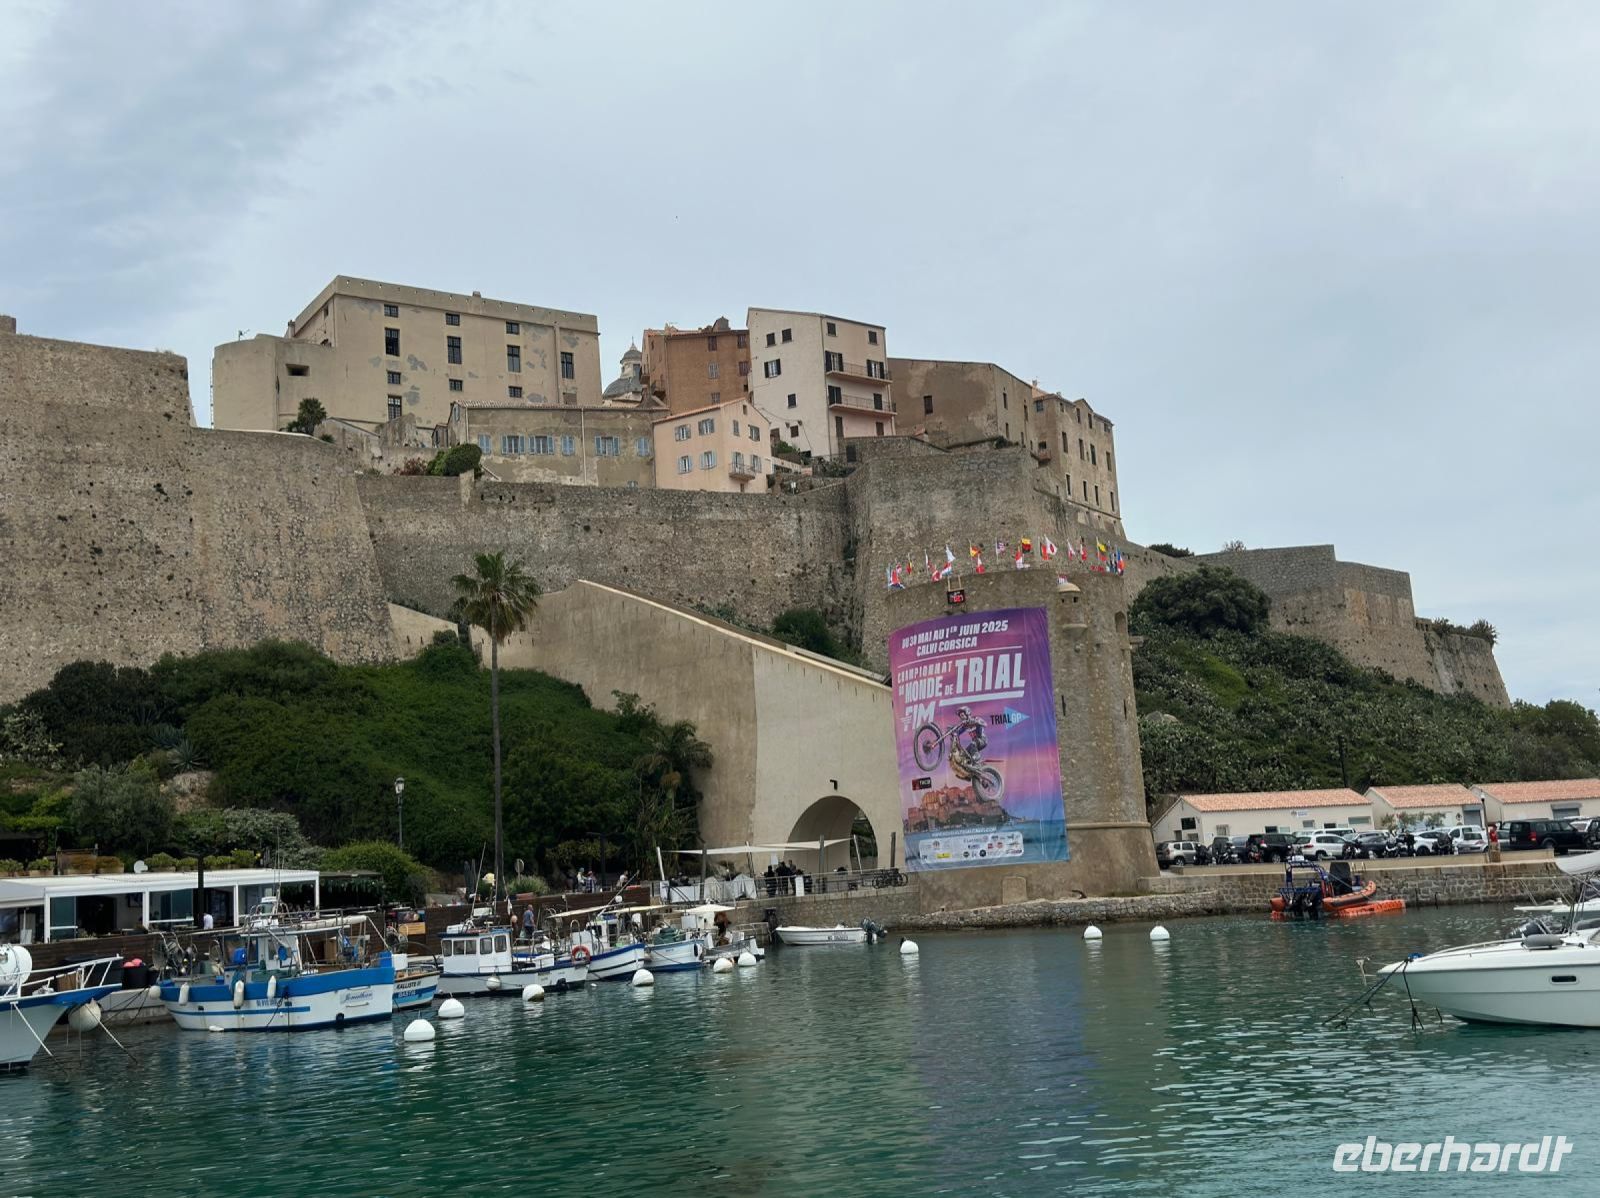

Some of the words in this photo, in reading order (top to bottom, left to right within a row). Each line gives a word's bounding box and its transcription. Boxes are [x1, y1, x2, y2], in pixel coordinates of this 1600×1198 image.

[918, 632, 932, 644] MAI
[933, 629, 945, 641] AU
[959, 624, 980, 636] JUIN
[982, 620, 1008, 633] 2025
[917, 642, 938, 657] CALVI
[938, 637, 977, 652] CORSICA
[898, 661, 952, 684] CHAMPIONNAT
[905, 676, 943, 704] MONDE
[944, 683, 954, 696] DE
[955, 653, 1025, 694] TRIAL
[904, 701, 936, 732] FIM
